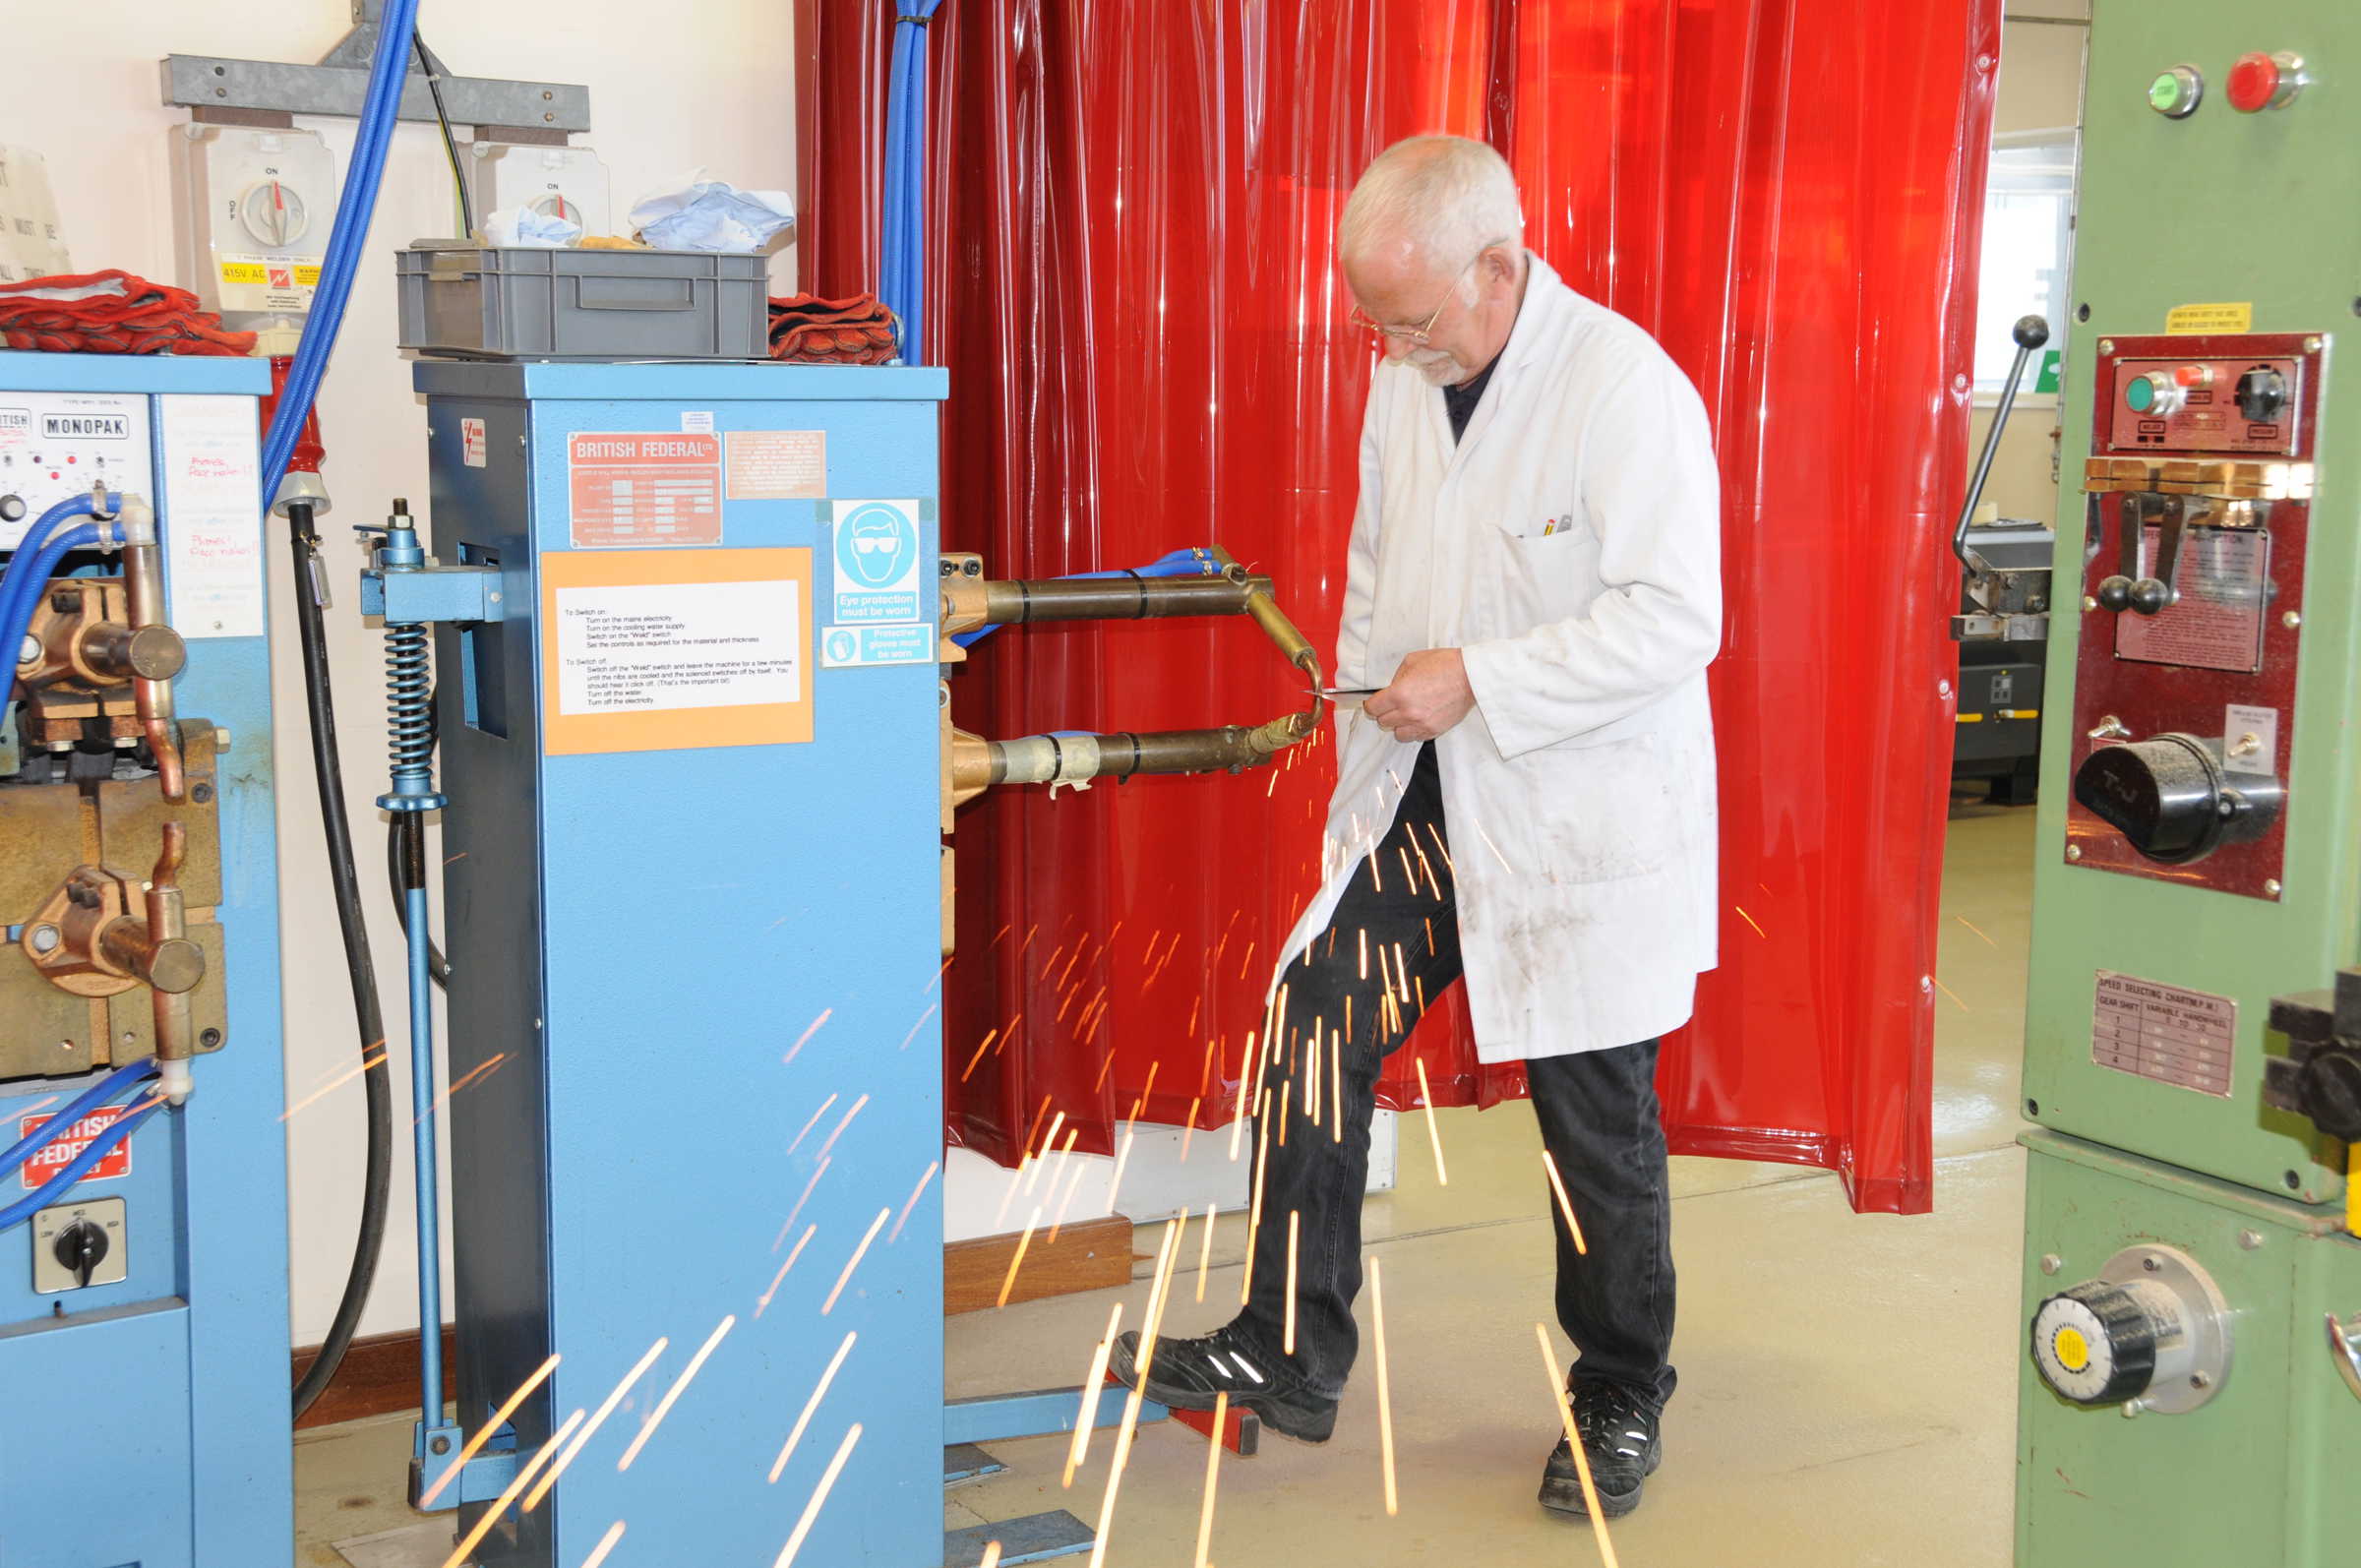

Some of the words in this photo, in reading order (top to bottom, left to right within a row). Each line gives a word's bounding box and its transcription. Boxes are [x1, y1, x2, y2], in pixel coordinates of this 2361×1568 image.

[47, 419, 124, 434] MONOPAK
[576, 441, 636, 458] BRITISH
[641, 441, 704, 458] FEDERAL
[840, 595, 859, 607] Eye
[862, 594, 914, 606] protection
[842, 606, 868, 616] must
[871, 605, 883, 616] be
[885, 607, 911, 616] worn
[643, 615, 672, 624] electricity
[623, 624, 644, 633] cooling
[874, 629, 918, 638] Protective
[900, 638, 922, 647] must
[878, 649, 890, 659] be
[2099, 978, 2121, 991] SPEED
[2125, 983, 2161, 999] SELECTING
[2099, 995, 2117, 1006] GEAR
[2119, 1000, 2140, 1011] SHIFT
[2146, 1003, 2179, 1017] VARIABLE
[2114, 1029, 2121, 1038] 2
[2113, 1042, 2120, 1051] 3
